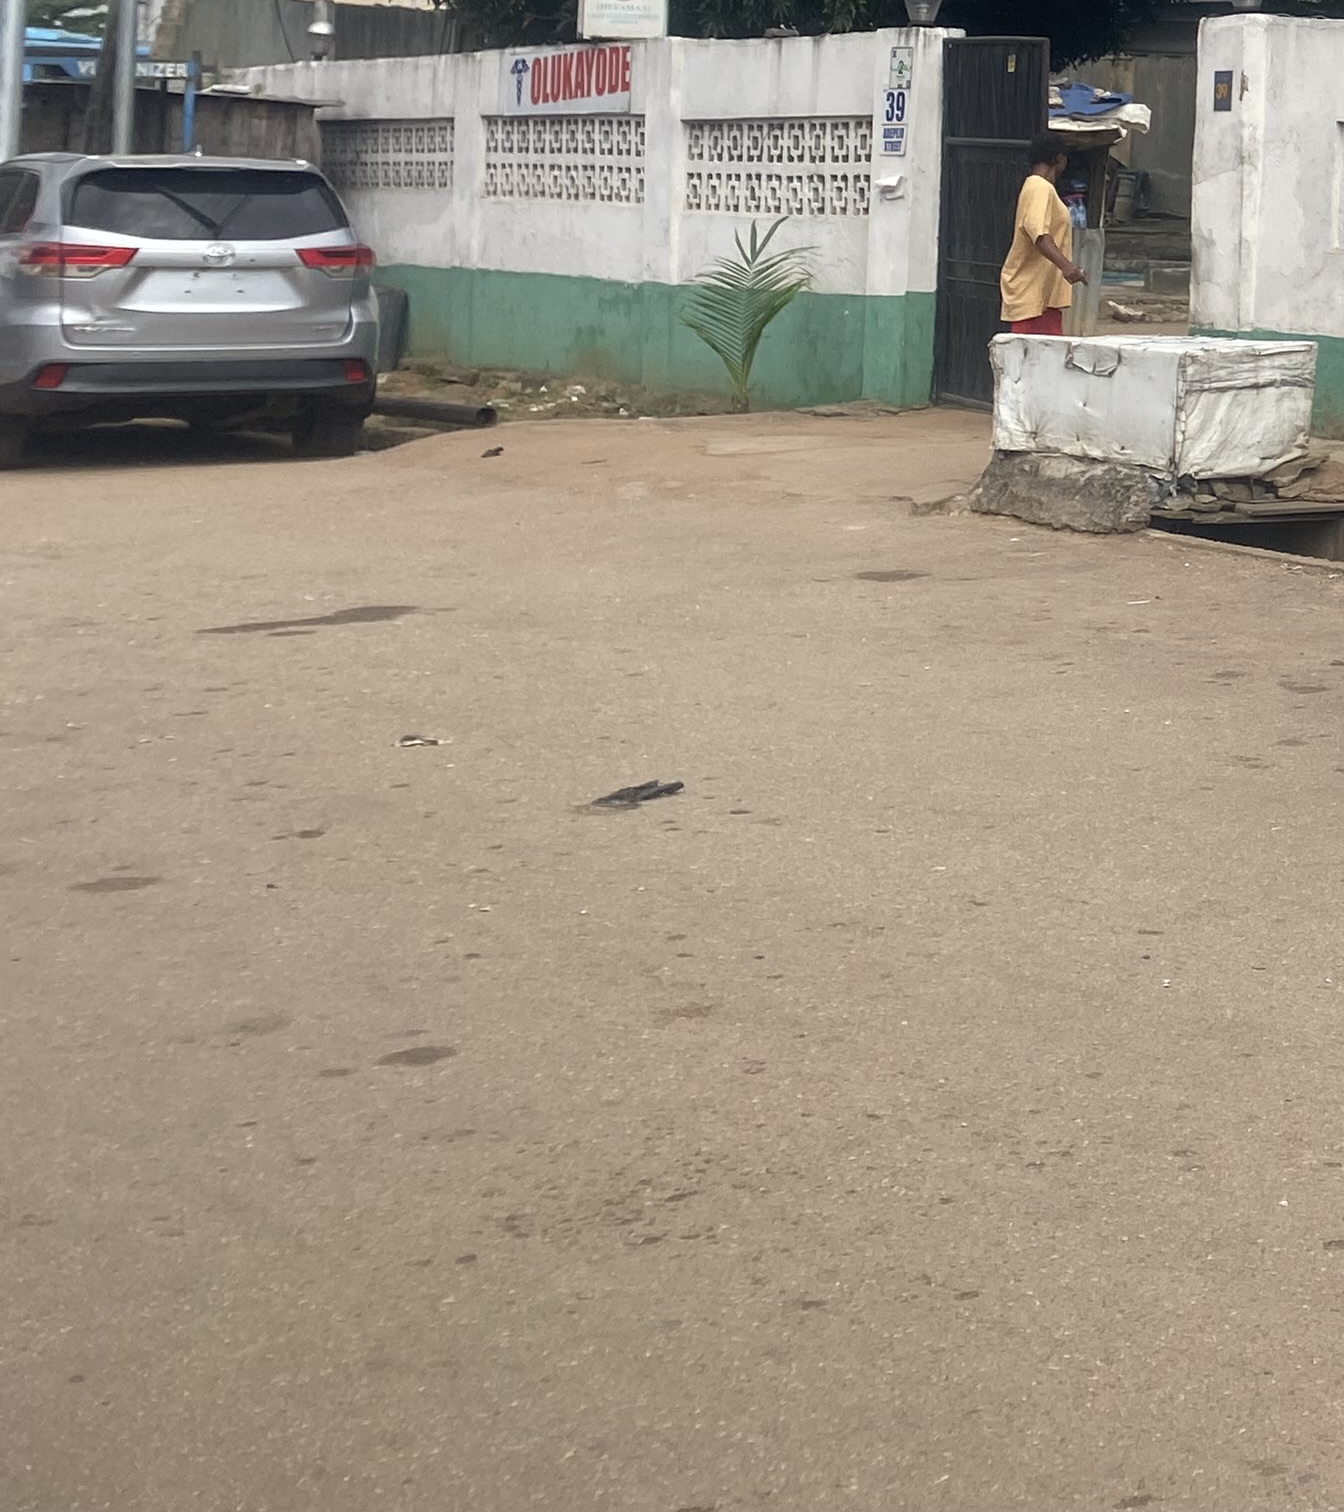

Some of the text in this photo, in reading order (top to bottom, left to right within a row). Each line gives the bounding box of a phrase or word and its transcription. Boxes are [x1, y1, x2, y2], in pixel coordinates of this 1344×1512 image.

[531, 46, 630, 105] OLUKAYODE
[1216, 83, 1228, 99] 39
[886, 92, 905, 122] 39
